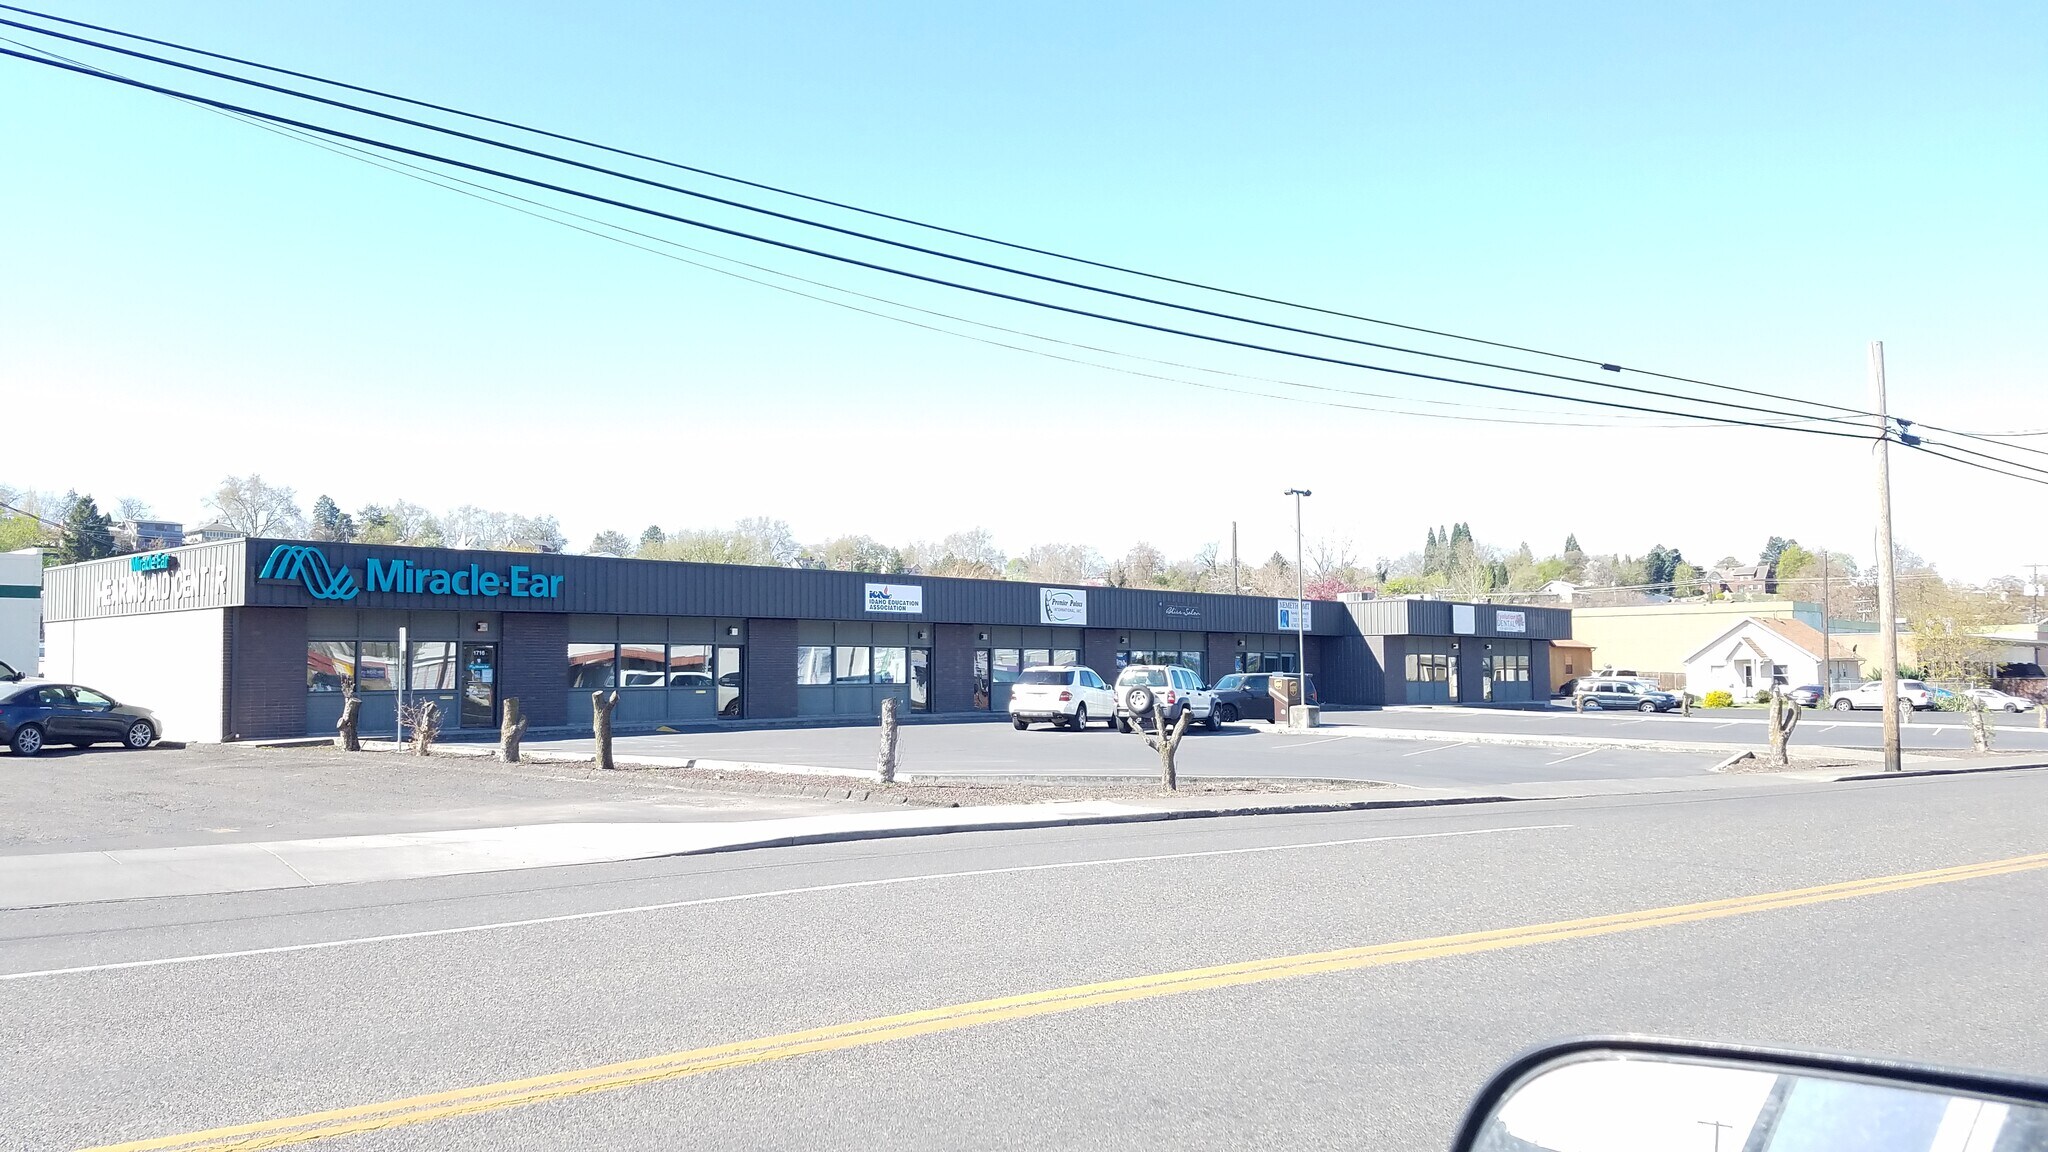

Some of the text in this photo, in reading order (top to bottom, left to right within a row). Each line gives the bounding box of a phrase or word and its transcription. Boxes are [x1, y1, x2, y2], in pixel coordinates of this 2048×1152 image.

[149, 570, 172, 602] AID
[174, 564, 228, 601] CENTR
[367, 558, 563, 598] Miracle-Ear
[1052, 598, 1069, 606] Premier
[1279, 601, 1299, 609] NEMETH
